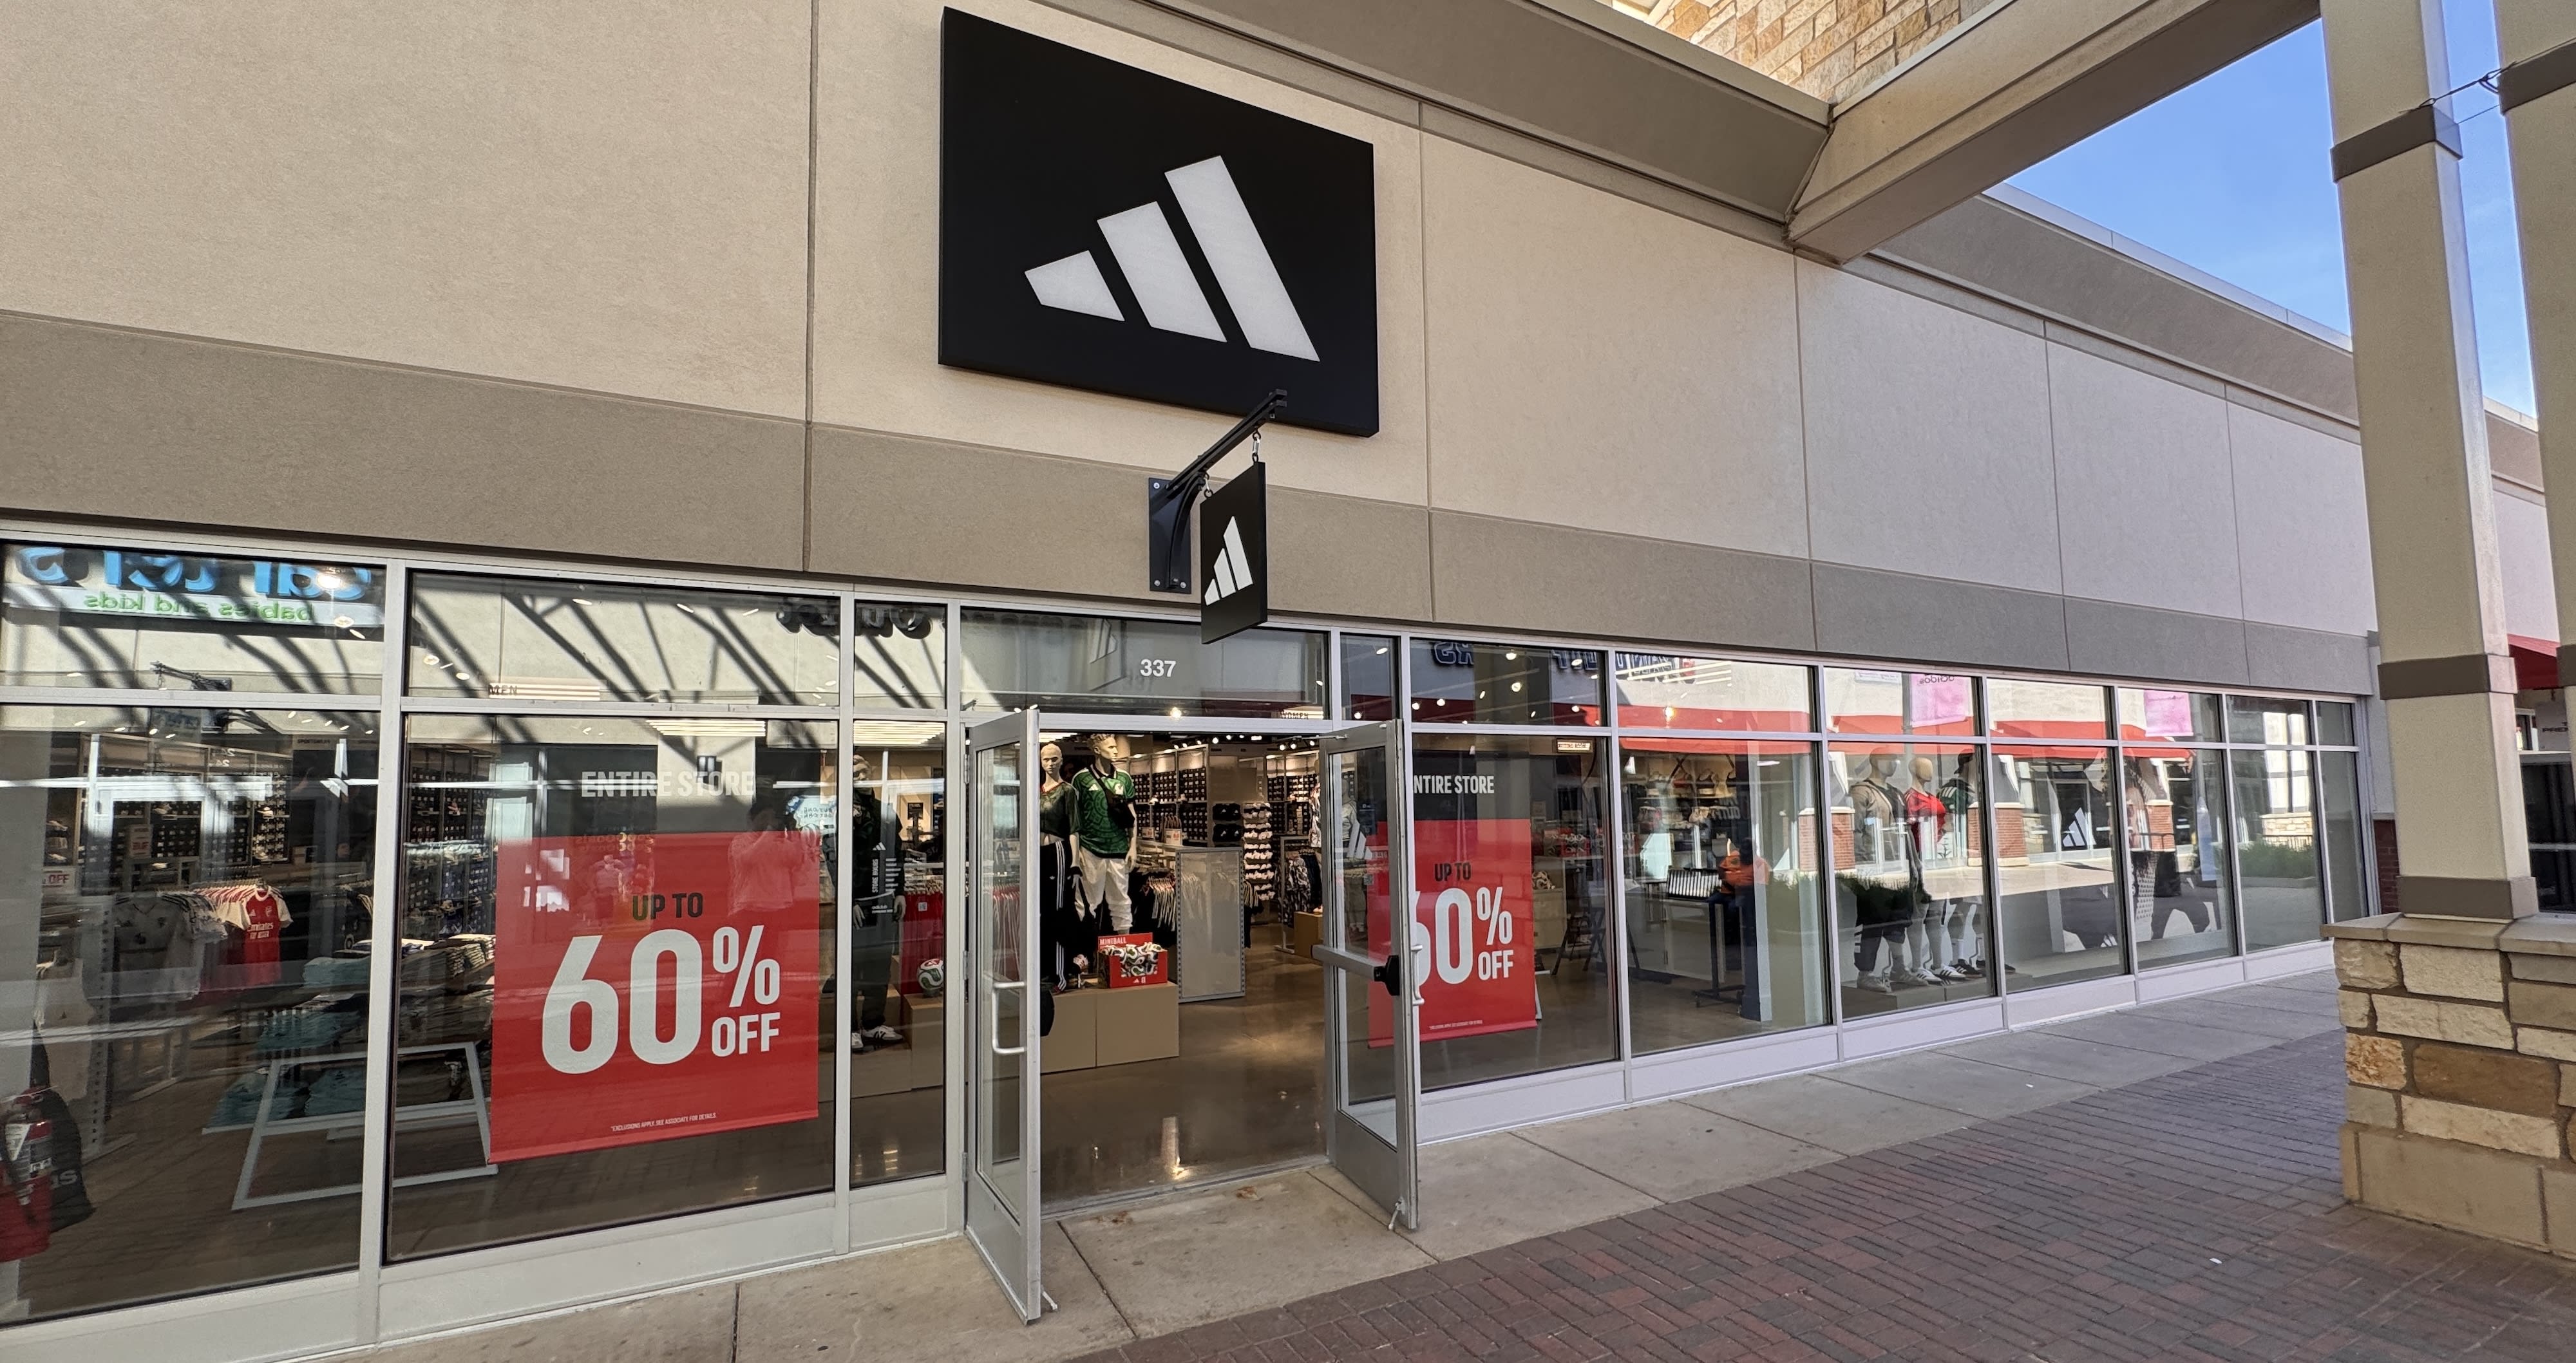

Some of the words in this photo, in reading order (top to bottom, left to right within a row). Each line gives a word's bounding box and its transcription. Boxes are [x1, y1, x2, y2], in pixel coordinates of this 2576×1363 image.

[1140, 659, 1177, 677] 337
[488, 684, 518, 695] MEN
[581, 771, 671, 798] ENTIRE
[677, 771, 755, 797] STORE
[1414, 775, 1452, 794] NTIRE
[1454, 775, 1495, 794] STORE
[1434, 863, 1452, 882] UP
[1454, 861, 1472, 881] TO
[632, 894, 665, 921] UP
[672, 892, 703, 919] TO
[1099, 937, 1127, 945] MINIBALL
[1477, 950, 1513, 981] OFF
[542, 925, 781, 1074] 60%
[712, 1012, 781, 1057] OFF
